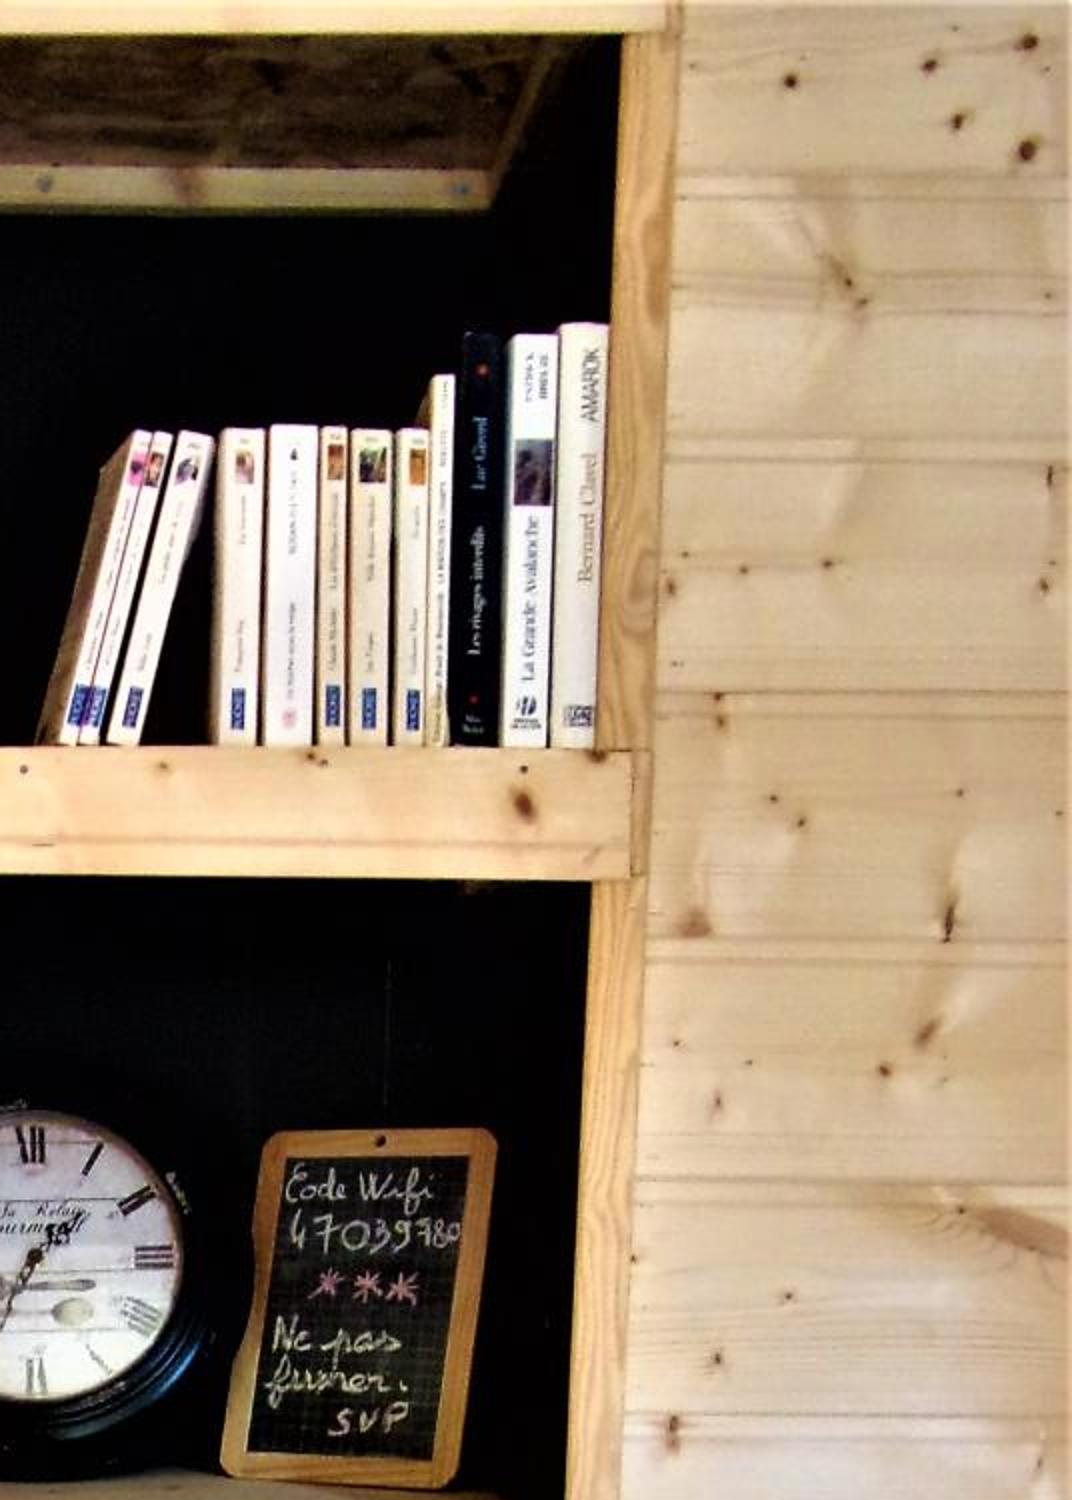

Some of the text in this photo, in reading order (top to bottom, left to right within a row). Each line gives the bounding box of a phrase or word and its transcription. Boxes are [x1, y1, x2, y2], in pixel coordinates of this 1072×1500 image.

[581, 348, 601, 423] AMAROK
[577, 453, 599, 582] Bernard Clavel
[521, 599, 538, 658] Grande
[520, 660, 536, 682] La
[285, 1162, 348, 1203] Code
[320, 1327, 403, 1371] pas
